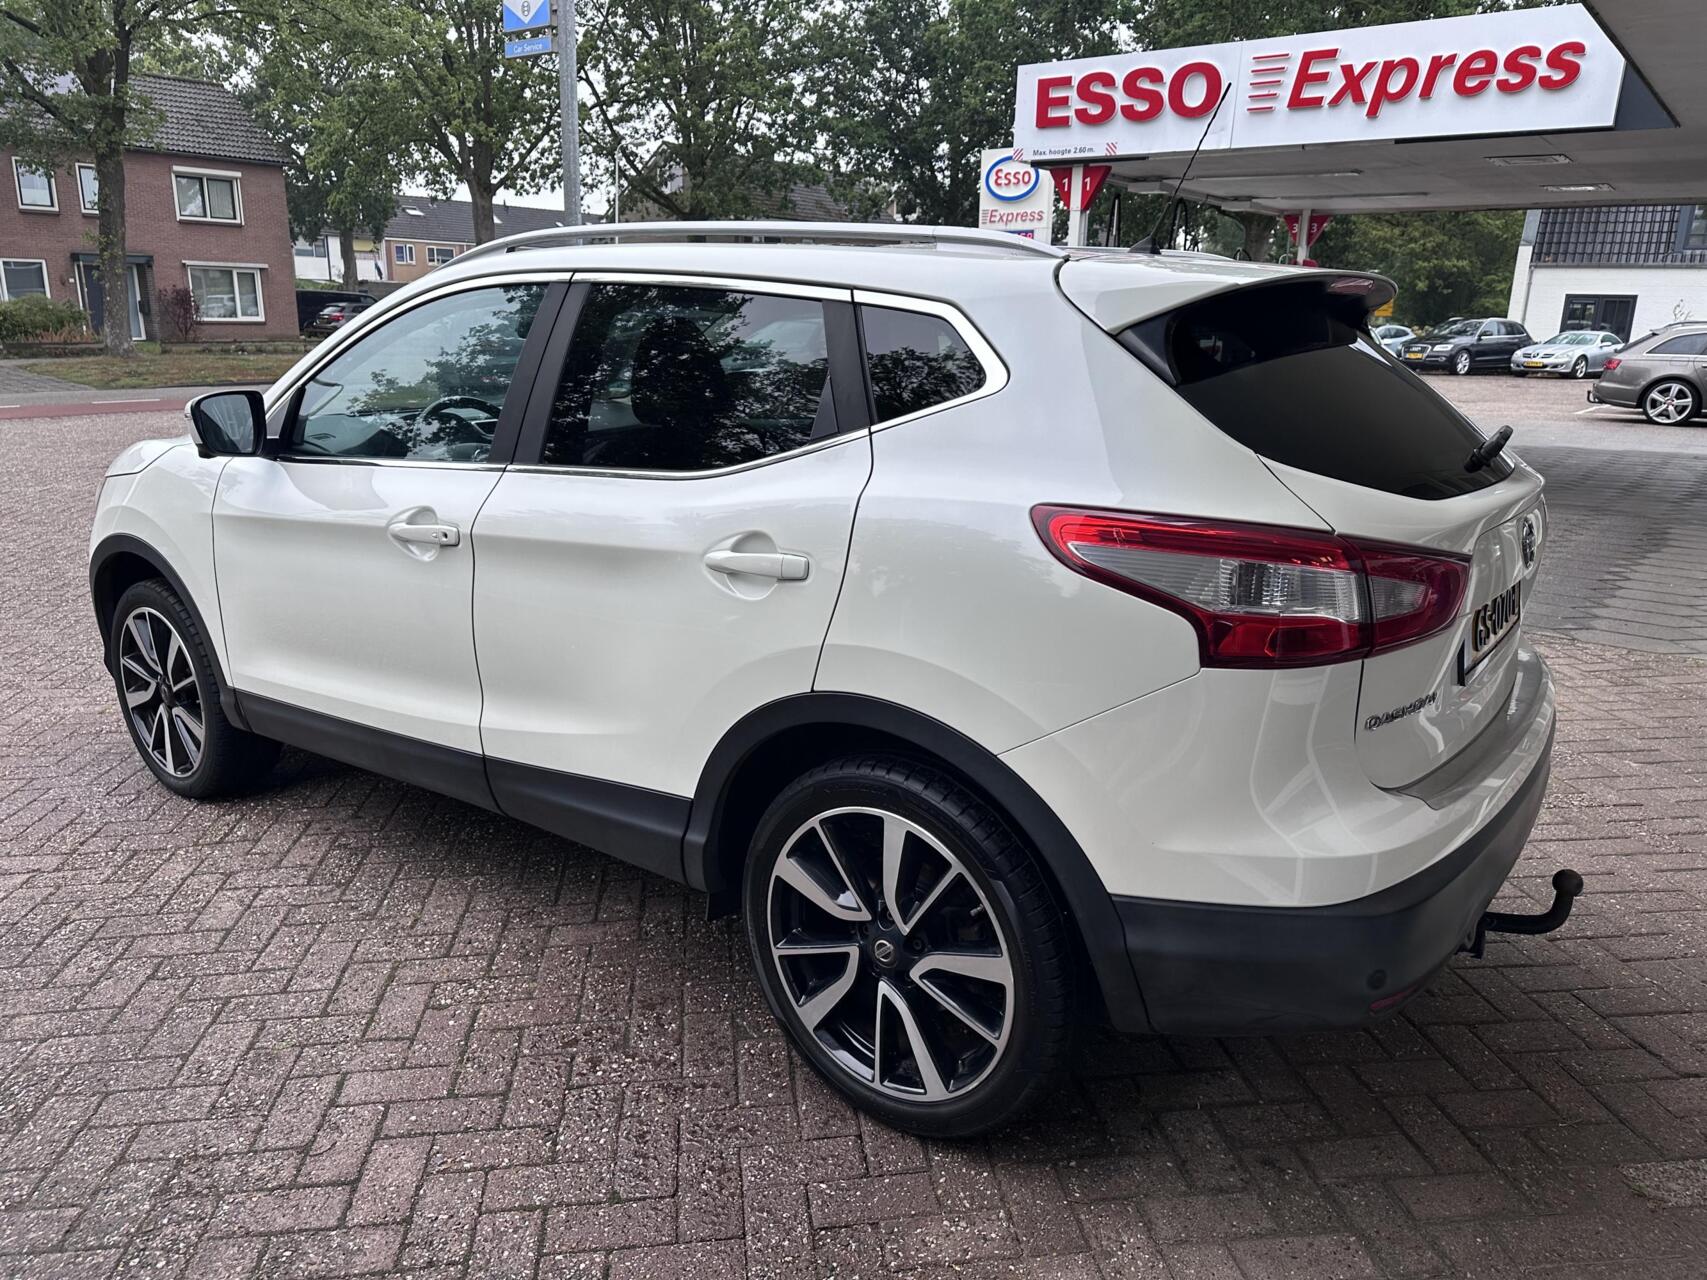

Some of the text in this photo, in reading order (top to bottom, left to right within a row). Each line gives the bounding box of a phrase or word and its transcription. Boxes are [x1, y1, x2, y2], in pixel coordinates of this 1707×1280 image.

[513, 43, 543, 53] Car Service
[1035, 40, 1587, 129] ESSO Express
[1048, 148, 1072, 156] hoogte
[994, 168, 1032, 187] Esso
[1062, 177, 1069, 192] 1
[1084, 176, 1091, 192] 1
[988, 209, 1045, 227] Express
[1292, 223, 1298, 233] 3
[1311, 223, 1318, 233] 3
